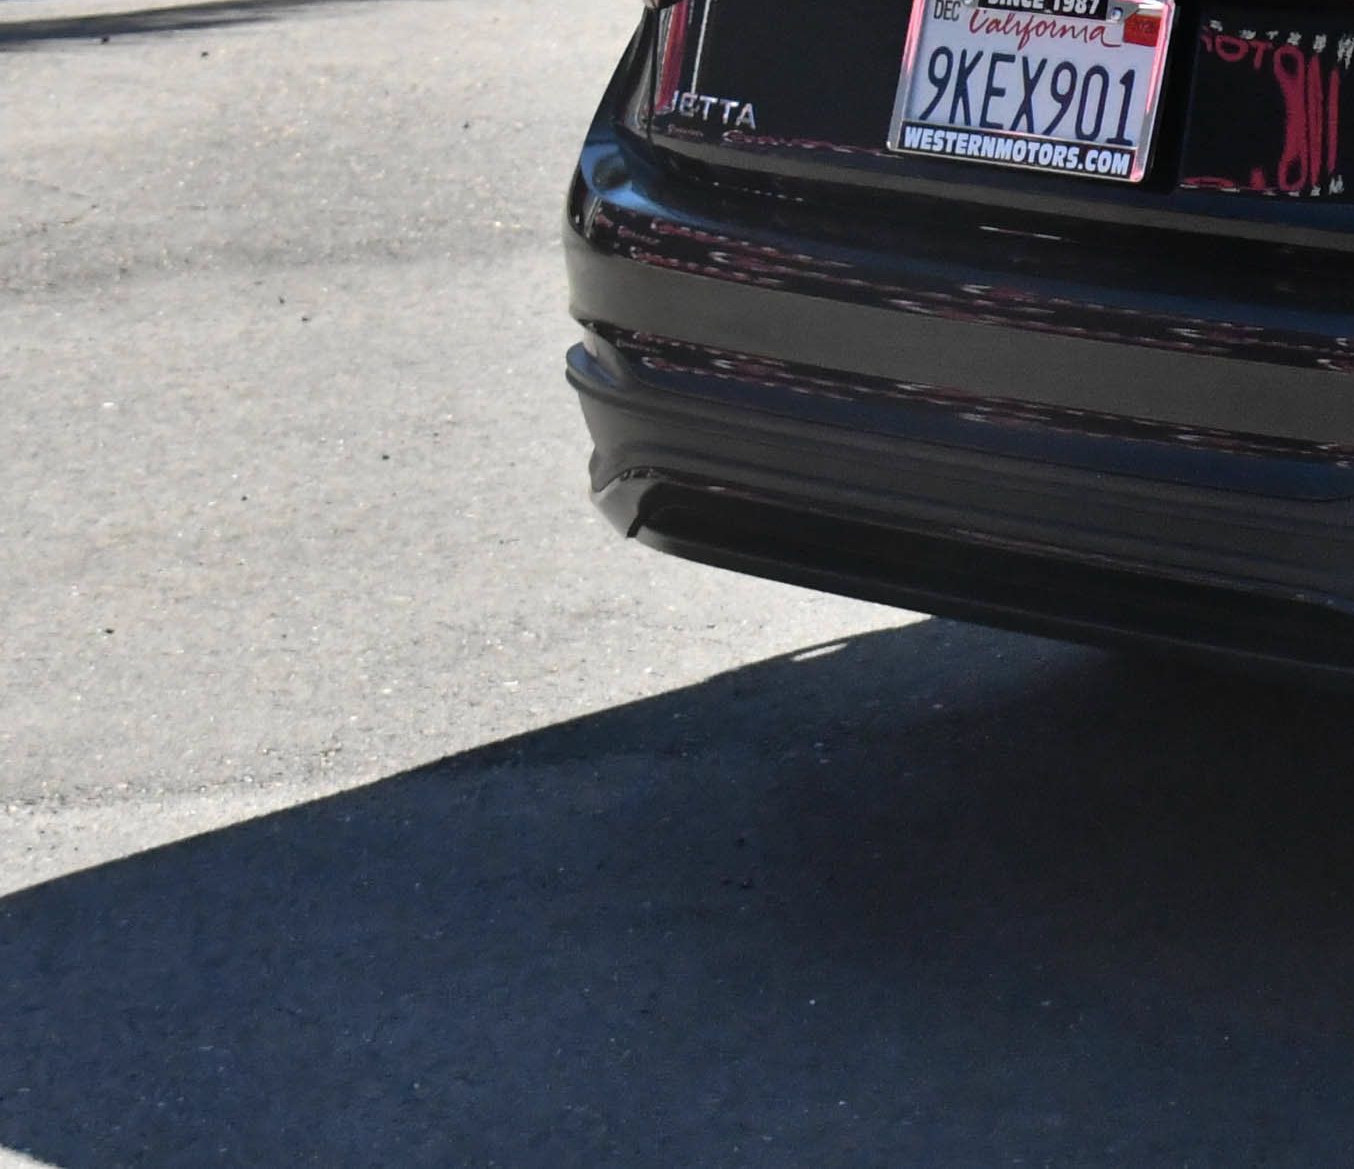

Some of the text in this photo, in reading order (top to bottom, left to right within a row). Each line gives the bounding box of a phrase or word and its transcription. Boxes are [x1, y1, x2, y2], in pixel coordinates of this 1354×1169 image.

[968, 8, 1123, 51] California
[665, 90, 756, 130] JETTA
[919, 45, 1136, 147] 9KEX901
[903, 126, 1131, 176] WESTERNMOTORS.COM
